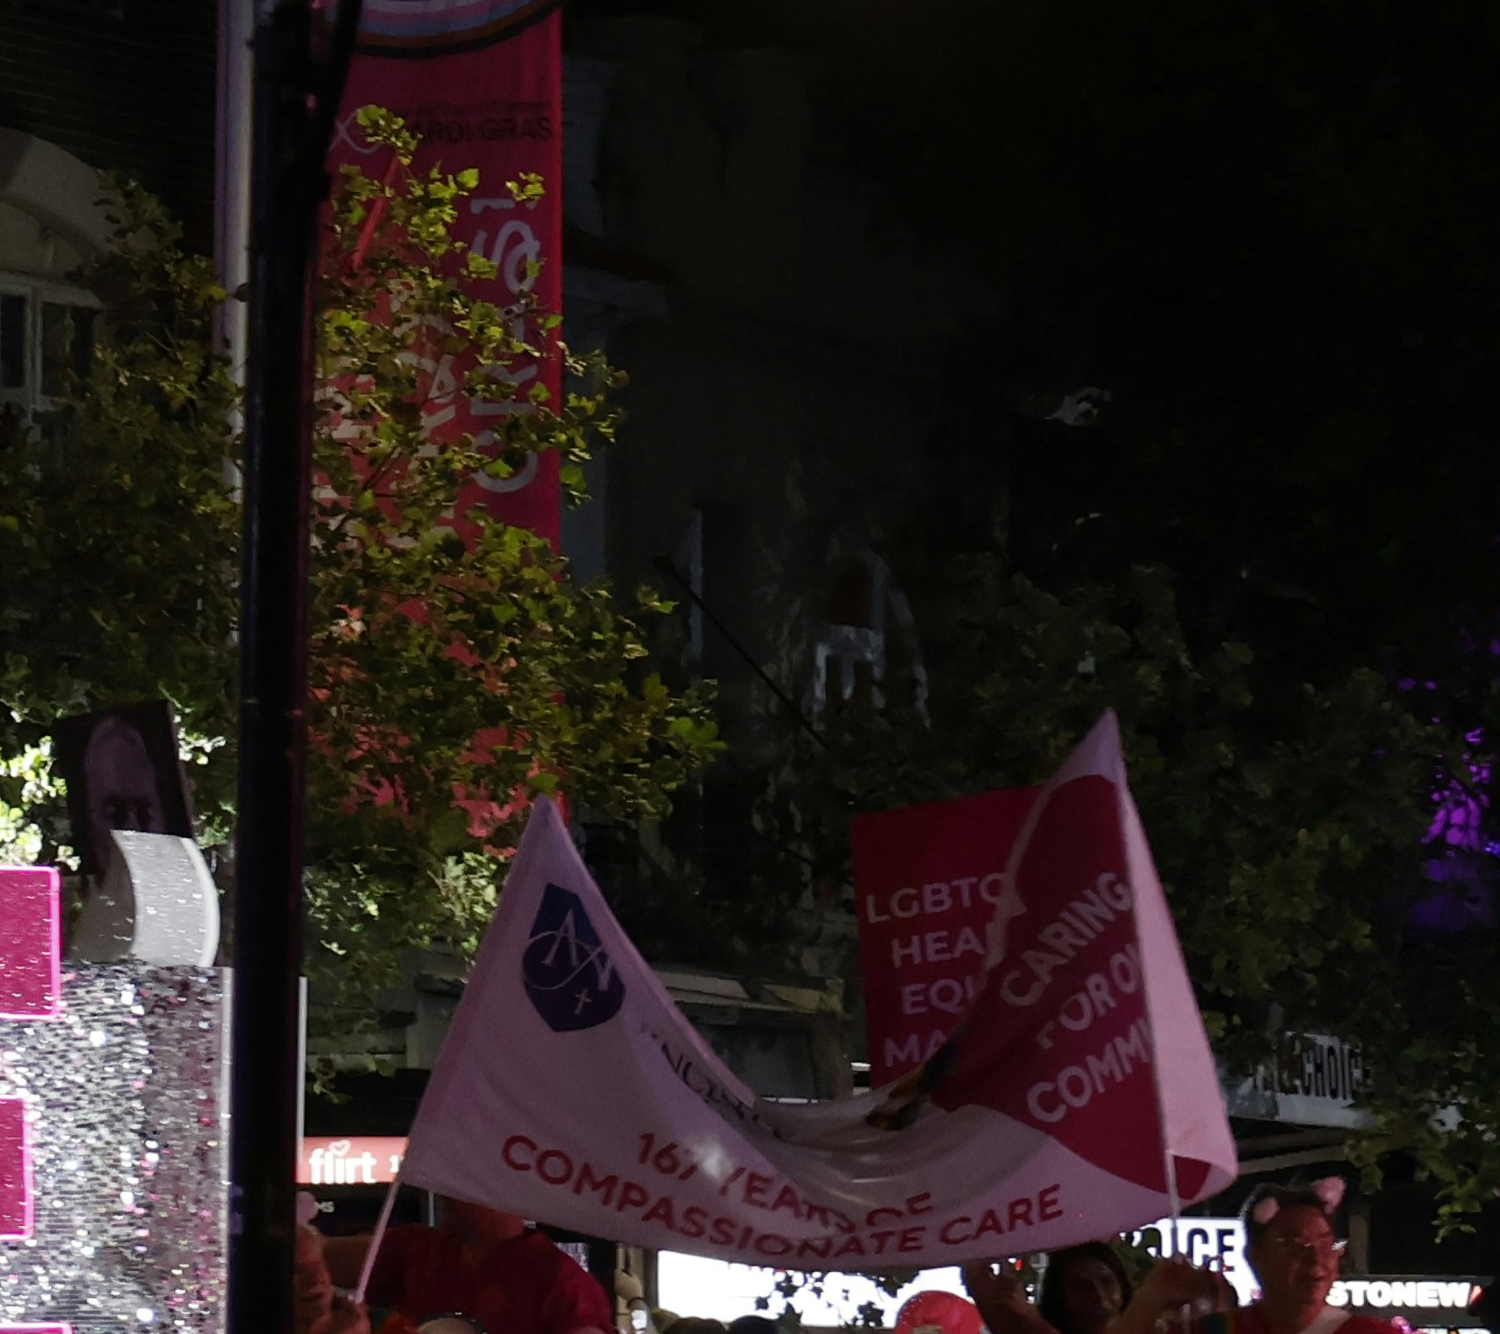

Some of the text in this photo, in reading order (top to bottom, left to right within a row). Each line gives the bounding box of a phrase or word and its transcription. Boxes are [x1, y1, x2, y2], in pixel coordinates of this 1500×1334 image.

[890, 926, 987, 968] HEA
[1001, 872, 1134, 1007] CARING
[1026, 1017, 1151, 1123] COMM
[308, 1140, 378, 1184] flirt
[502, 1134, 1063, 1259] COMPASSIONATE CARE
[1325, 1280, 1484, 1308] STONEW
